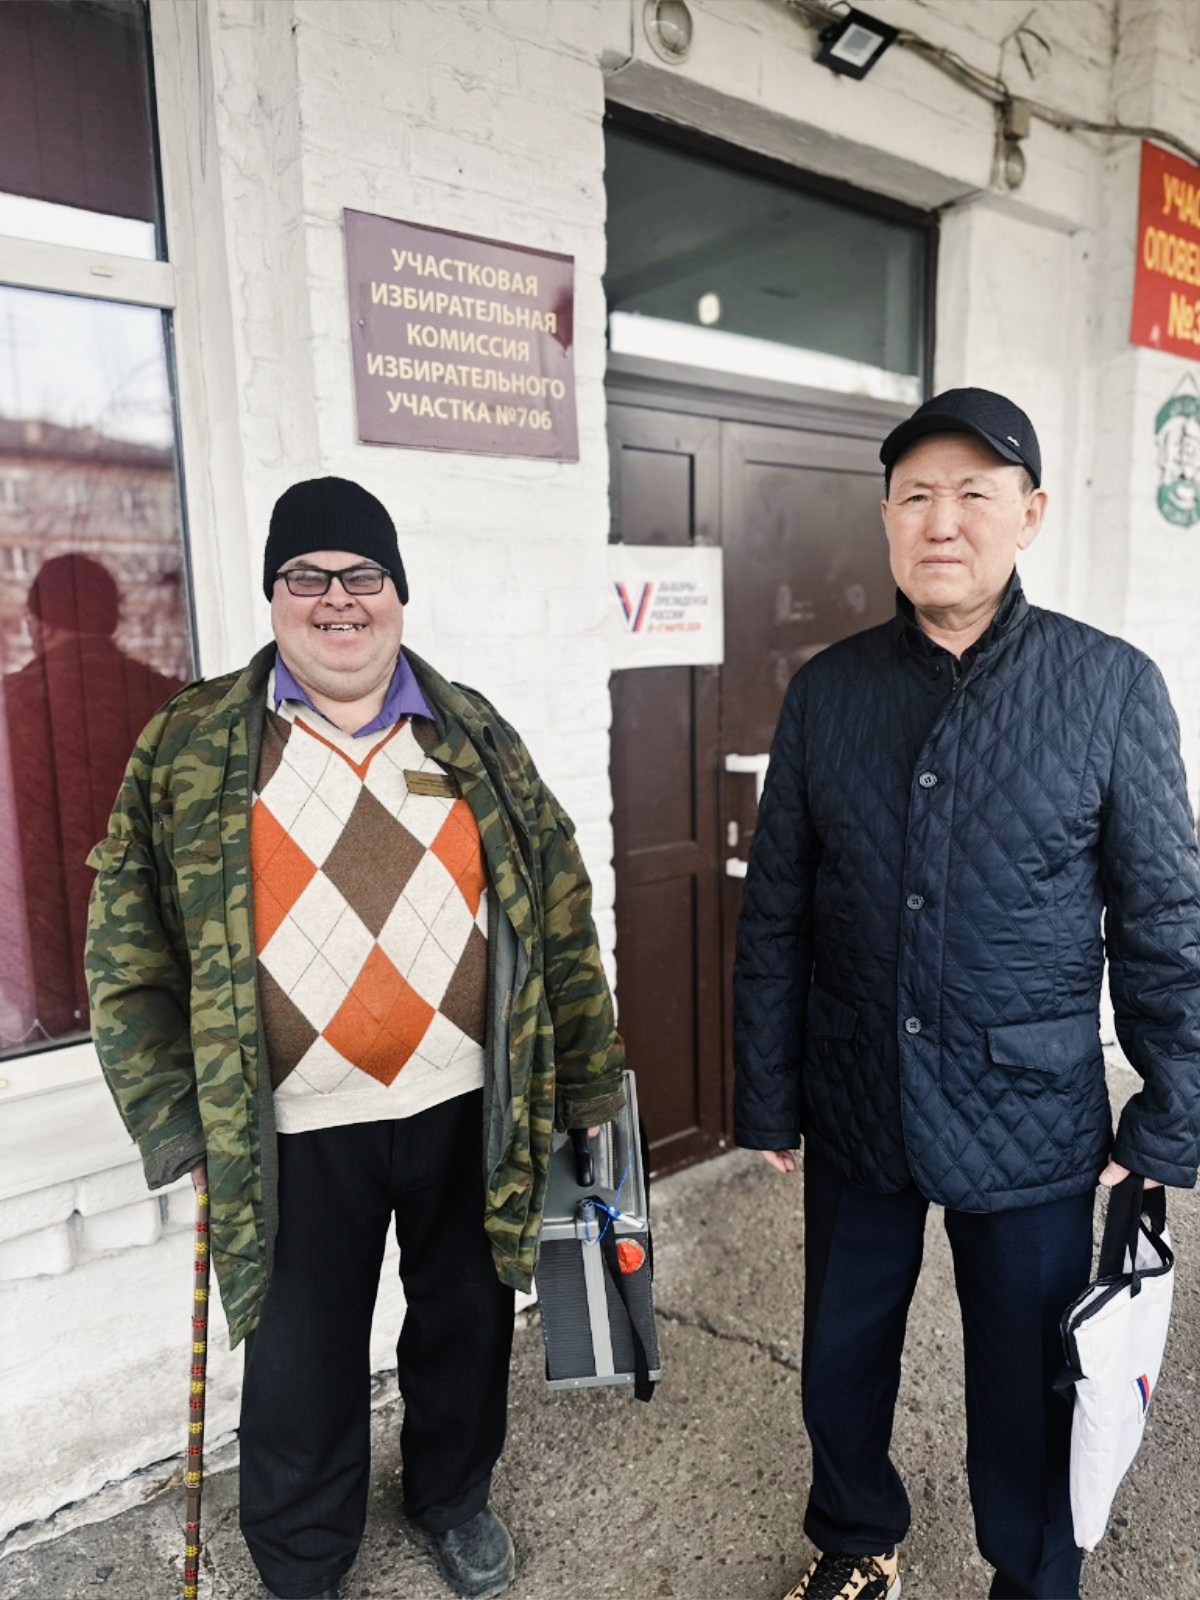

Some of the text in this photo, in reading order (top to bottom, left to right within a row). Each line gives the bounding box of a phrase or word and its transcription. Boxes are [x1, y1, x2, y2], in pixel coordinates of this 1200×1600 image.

[391, 248, 539, 298] УЧАСТКОВАЯ
[1143, 226, 1200, 286] ОПОВЕ
[370, 281, 558, 334] ИЗБИРАТЕЛЬНАЯ
[406, 322, 531, 363] КОМИССИЯ
[366, 352, 566, 400] ИЗБИРАТЕЛЬНОГО
[386, 390, 553, 430] УЧАСТКА №706
